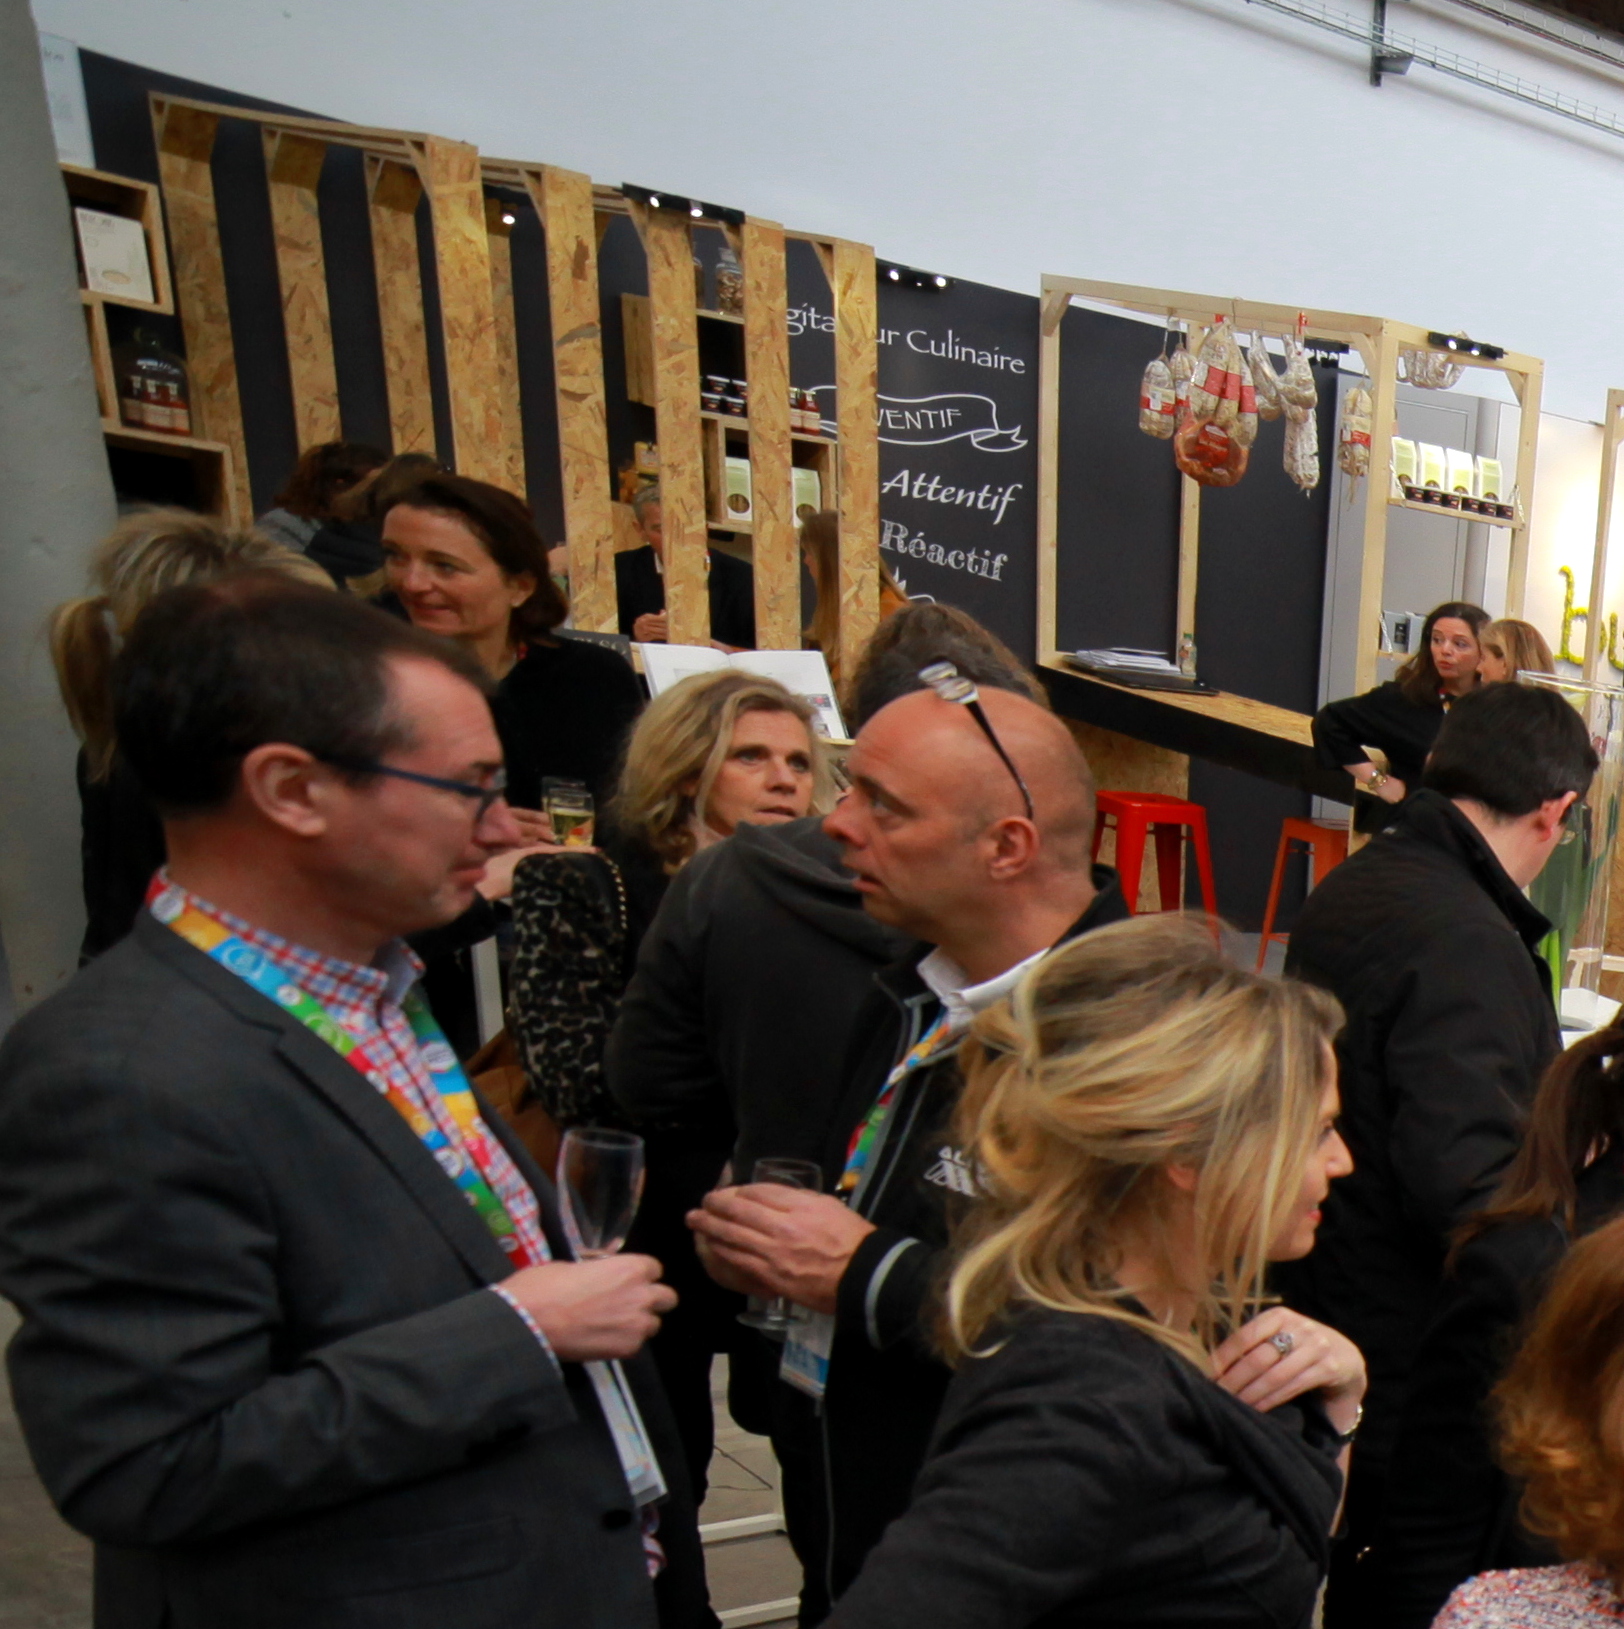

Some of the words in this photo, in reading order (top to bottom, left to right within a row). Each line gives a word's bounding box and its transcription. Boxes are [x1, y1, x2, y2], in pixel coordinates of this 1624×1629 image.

[906, 329, 1026, 375] Culinaire
[881, 469, 1023, 525] Attentif
[879, 518, 1009, 582] Réactif
